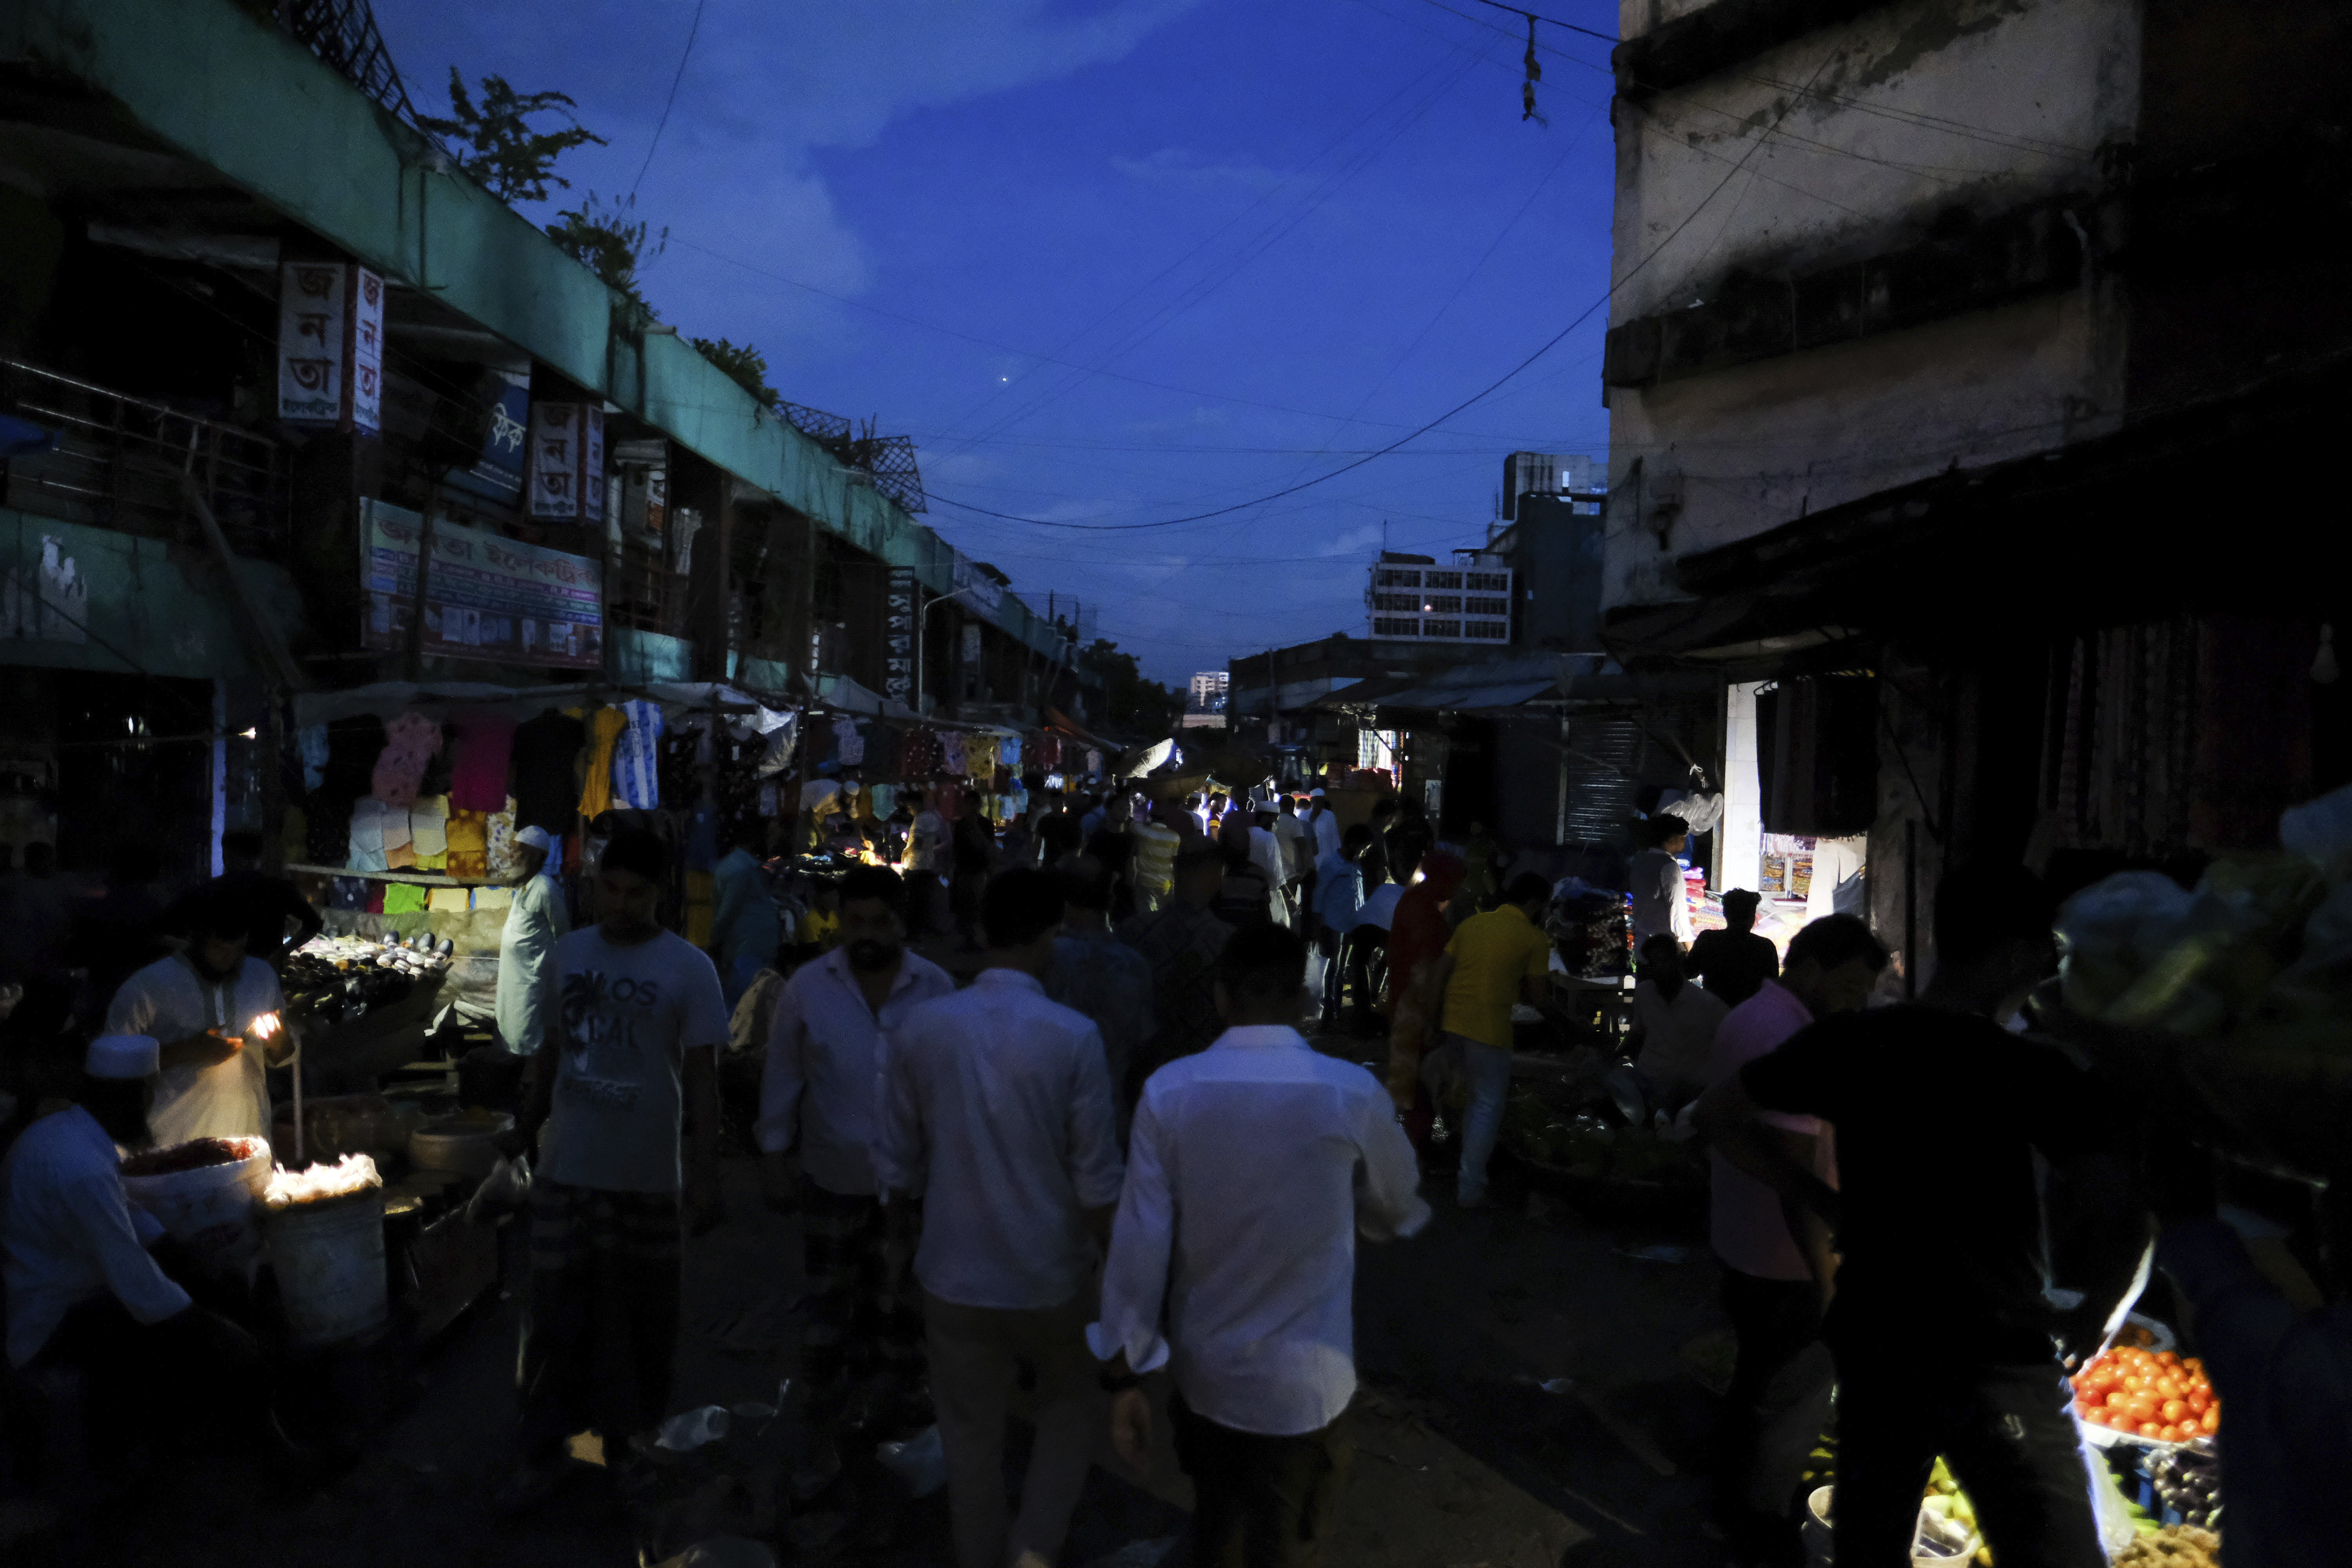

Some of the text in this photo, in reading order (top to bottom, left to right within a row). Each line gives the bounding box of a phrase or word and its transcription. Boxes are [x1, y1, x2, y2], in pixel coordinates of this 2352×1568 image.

[287, 267, 337, 394] জনতা
[540, 406, 572, 498] জনতা
[378, 518, 474, 561] জতা
